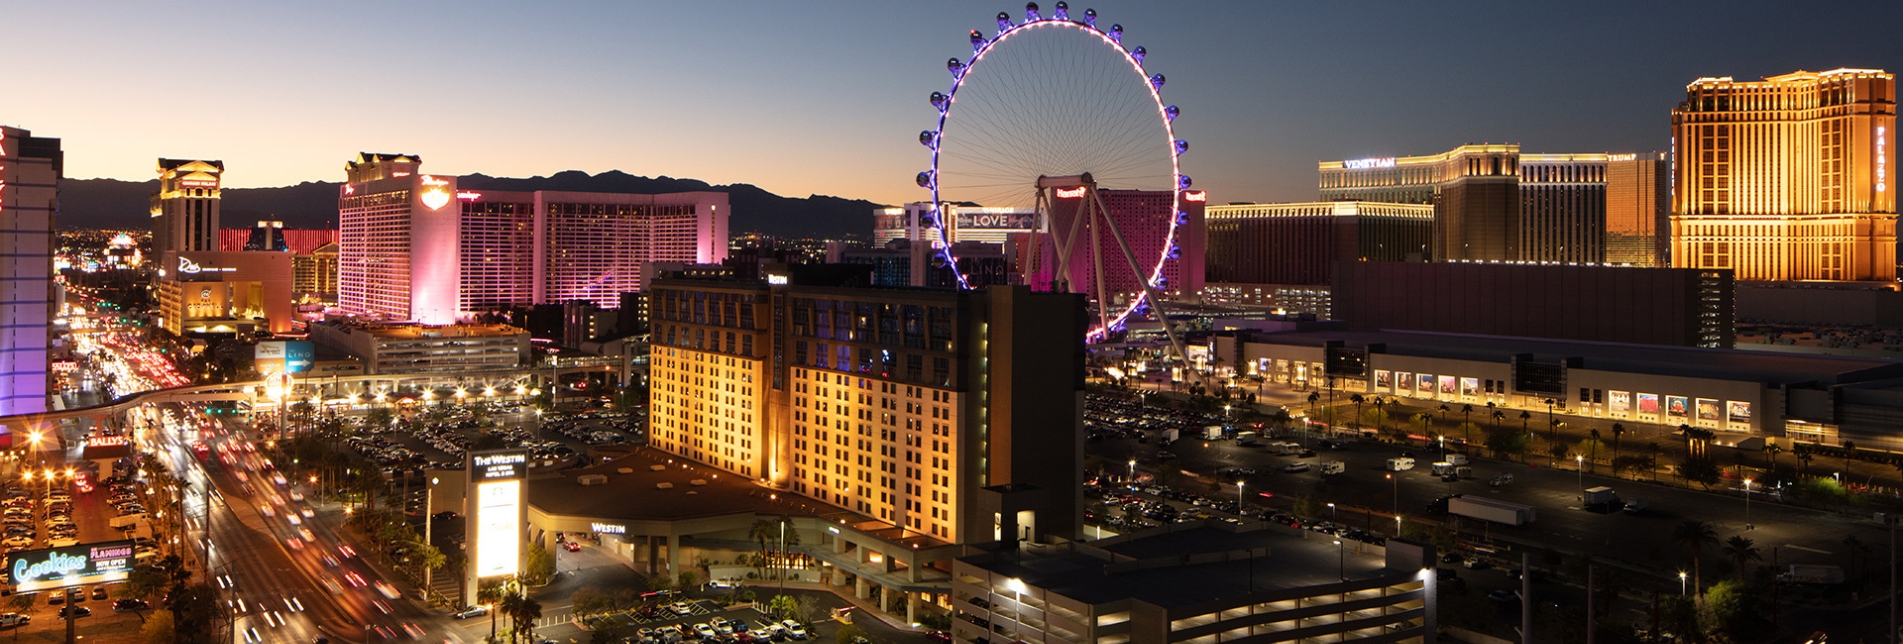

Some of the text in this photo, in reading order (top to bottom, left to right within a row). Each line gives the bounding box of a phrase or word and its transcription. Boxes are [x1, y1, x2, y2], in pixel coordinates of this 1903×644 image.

[1344, 157, 1396, 169] VENETIAN
[1607, 153, 1637, 162] TRUMP
[1876, 126, 1886, 192] PALAZZO
[973, 215, 1008, 227] LOVE
[970, 264, 1005, 275] LINQ
[90, 437, 123, 446] BALLY'S
[474, 454, 525, 466] THE WESTIN
[591, 522, 626, 534] WESTIN
[91, 548, 132, 559] FLAMINGO
[14, 552, 87, 582] Cookies
[110, 558, 126, 566] OPEN
